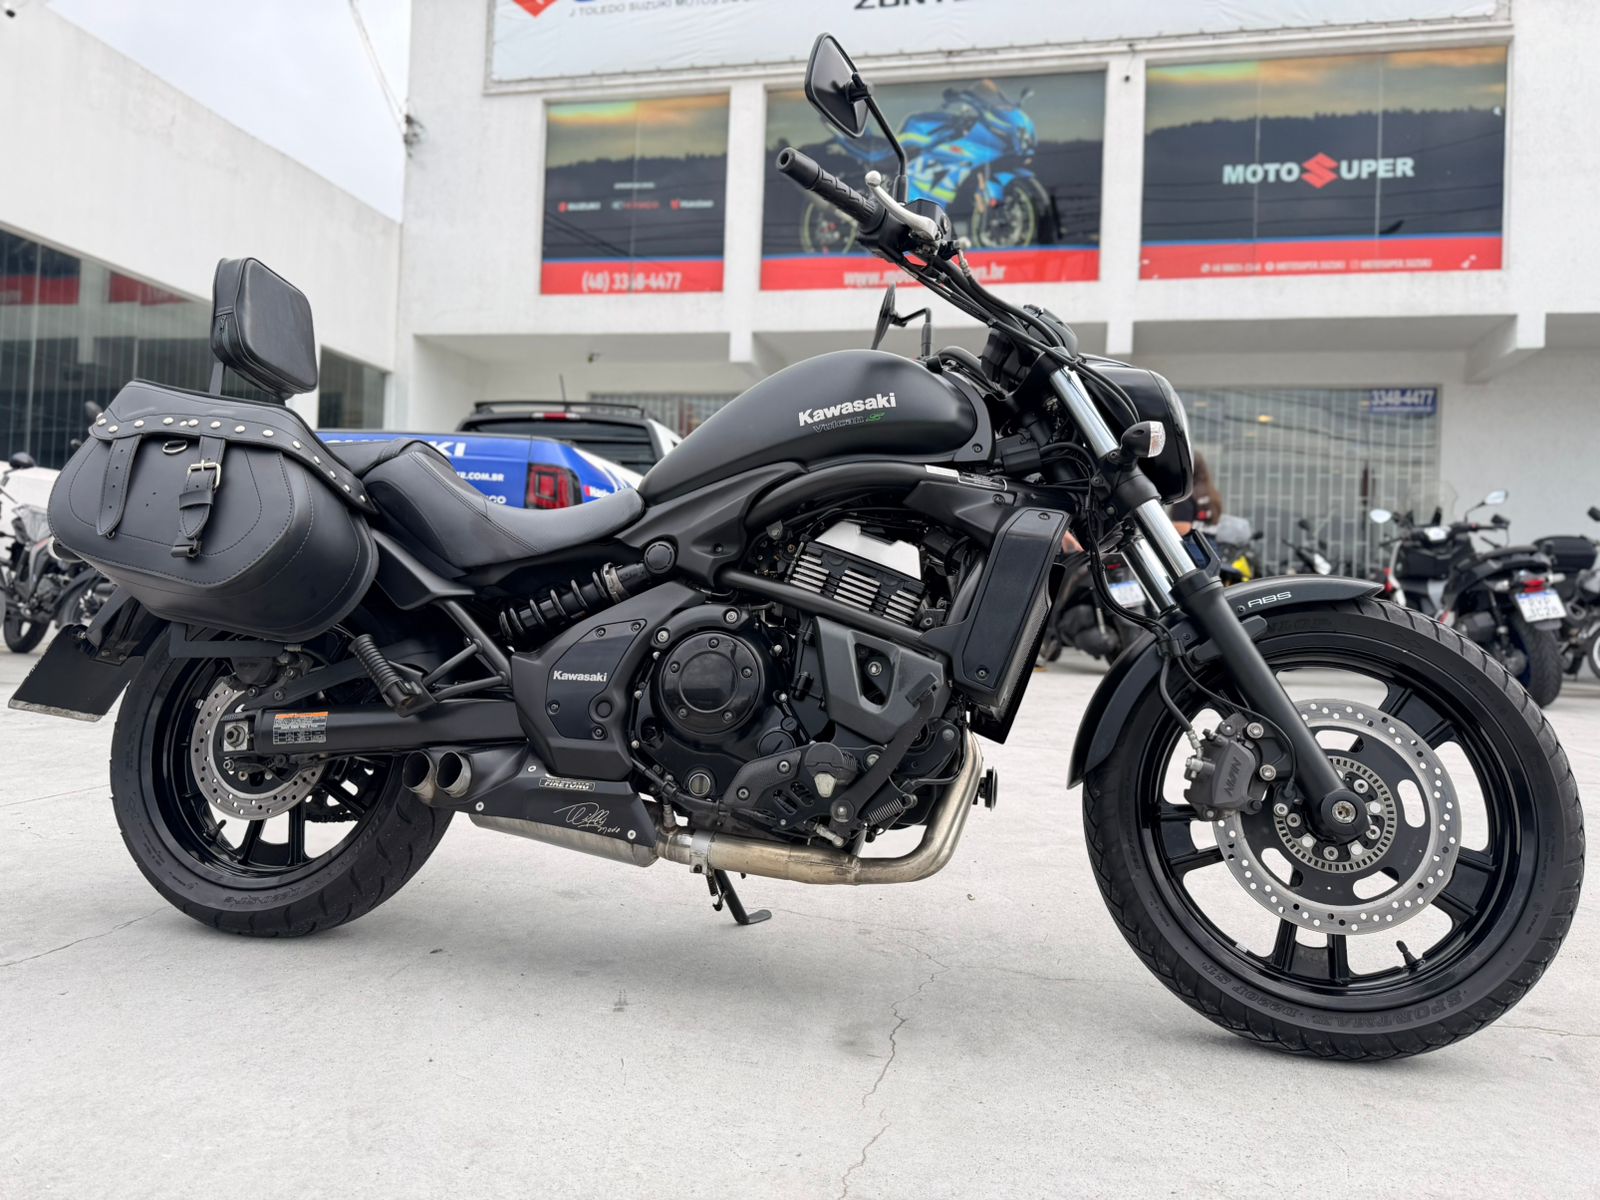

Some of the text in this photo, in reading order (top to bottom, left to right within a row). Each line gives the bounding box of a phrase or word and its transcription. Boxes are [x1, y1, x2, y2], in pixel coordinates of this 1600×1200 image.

[579, 4, 625, 17] TOLEDO
[798, 392, 897, 427] Kawasaki
[1247, 591, 1292, 608] ABS
[553, 670, 608, 682] Kawasaki
